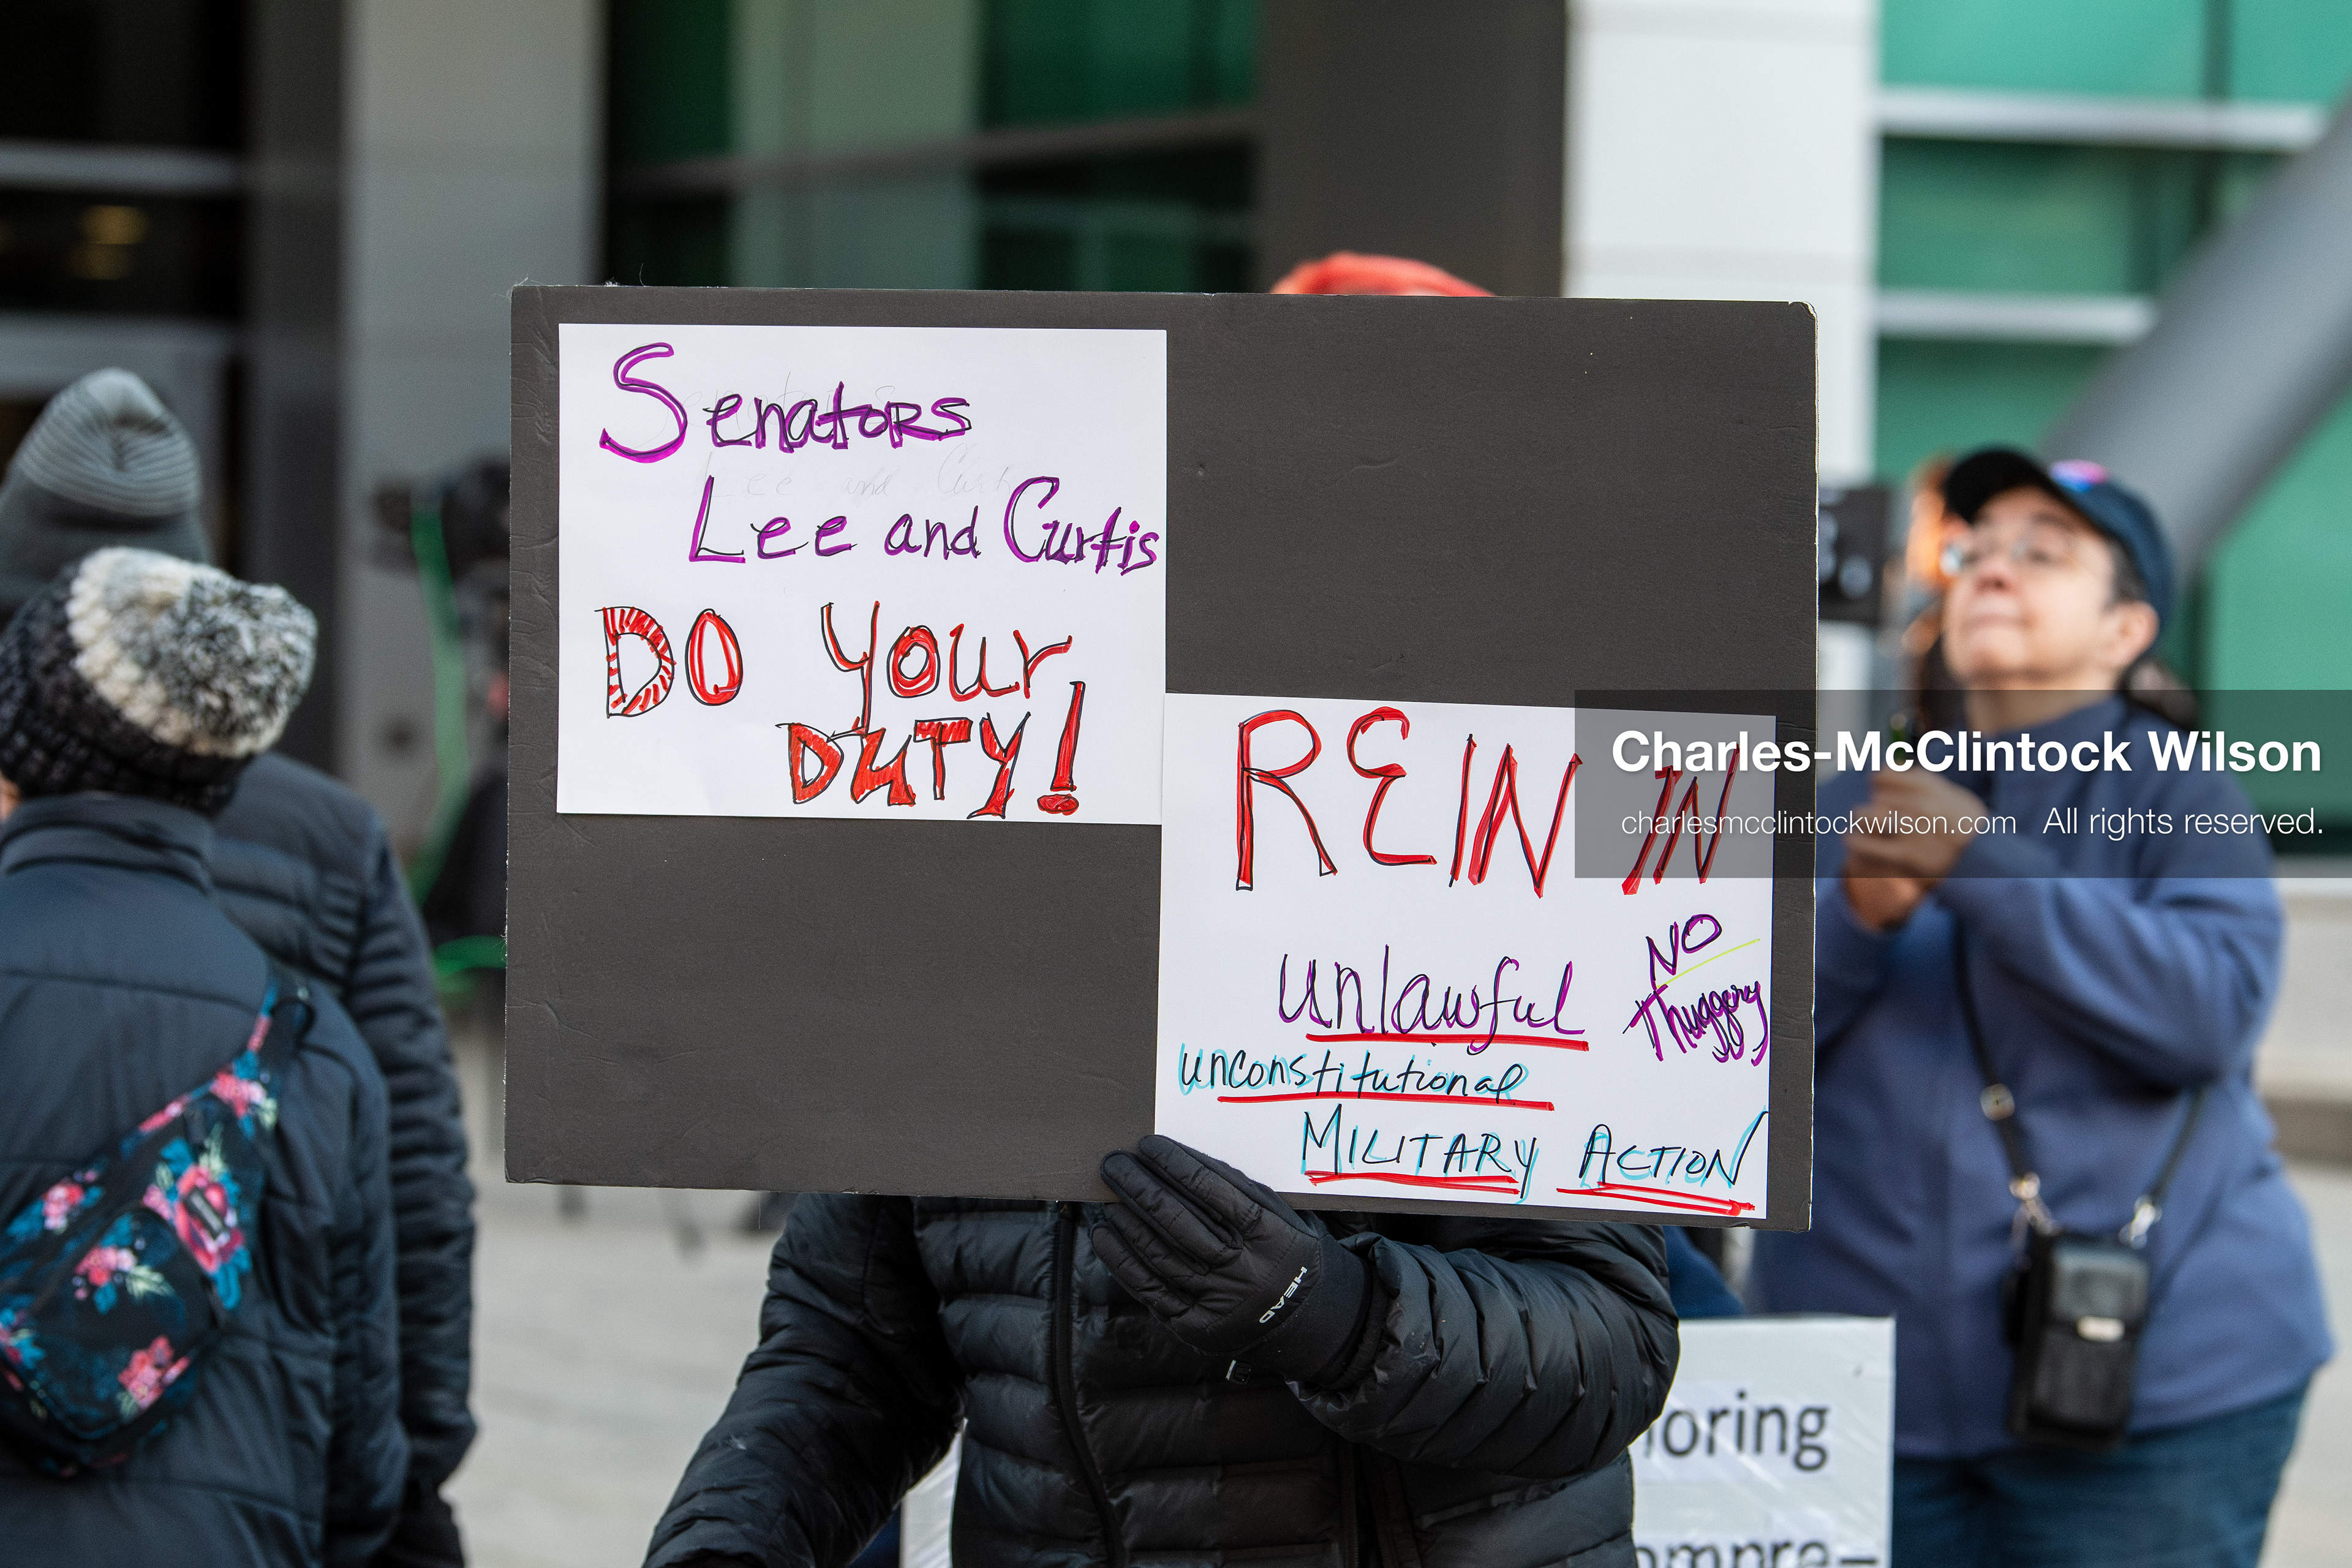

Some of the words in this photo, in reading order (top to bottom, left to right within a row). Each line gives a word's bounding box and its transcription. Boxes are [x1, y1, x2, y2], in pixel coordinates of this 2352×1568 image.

[688, 475, 858, 564] Lee
[884, 505, 982, 560] and
[1003, 475, 1160, 576] Curtis
[594, 606, 743, 718] DO
[1235, 706, 1584, 899] REIN
[1622, 742, 1740, 895] IN
[1578, 1103, 1769, 1189] ACTION
[1259, 1266, 1308, 1324] HEAD
[1644, 1388, 1830, 1472] oring
